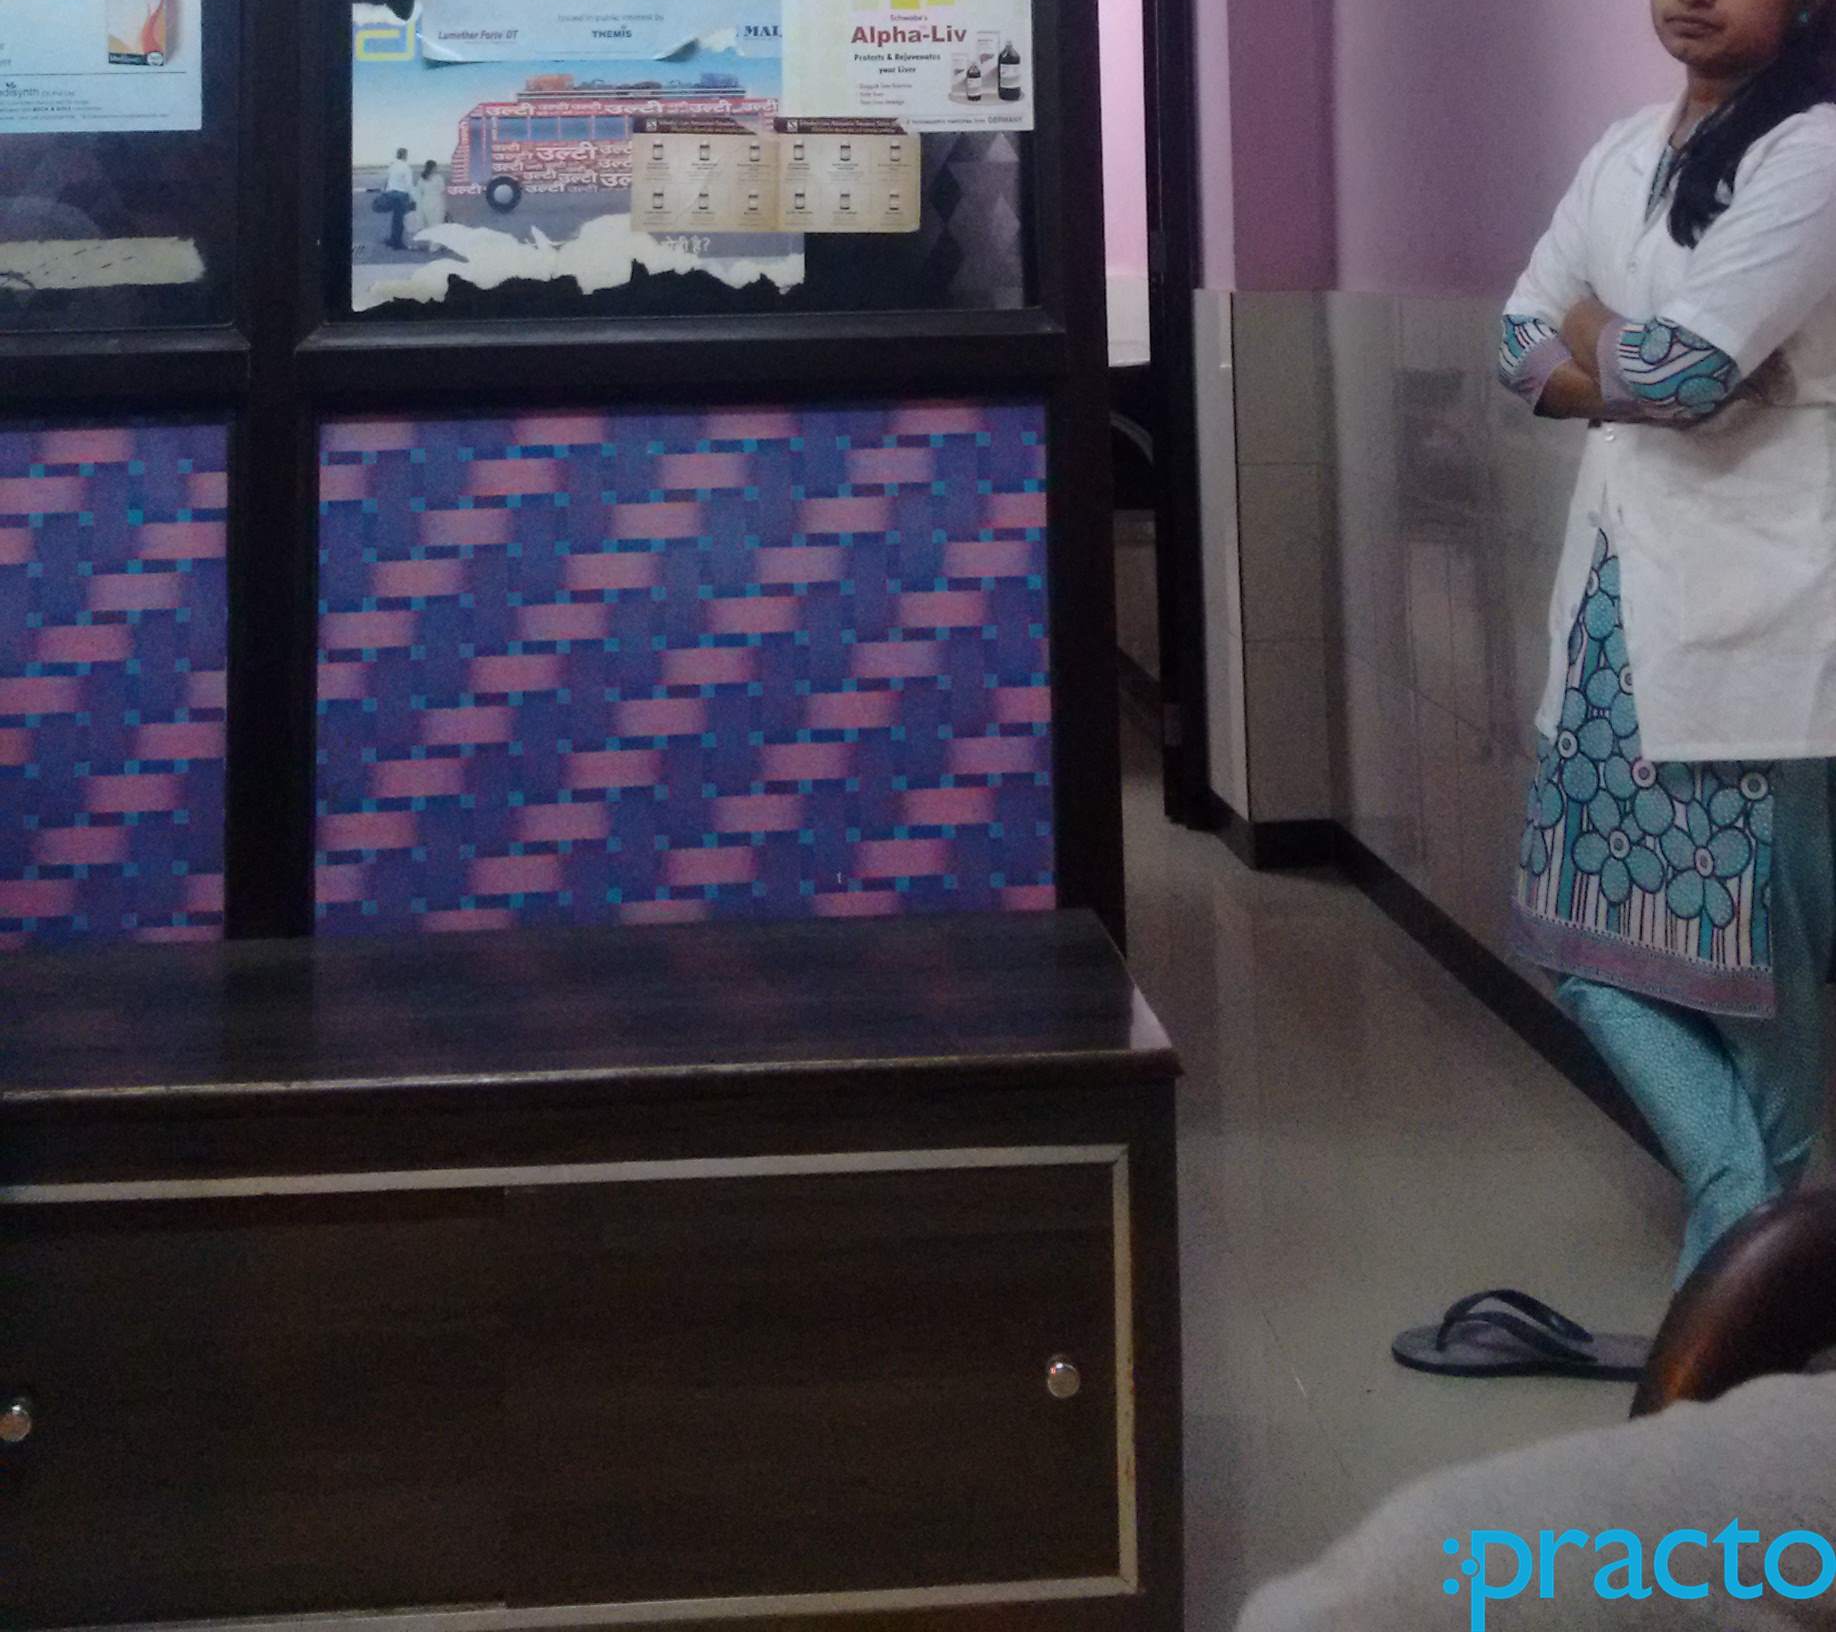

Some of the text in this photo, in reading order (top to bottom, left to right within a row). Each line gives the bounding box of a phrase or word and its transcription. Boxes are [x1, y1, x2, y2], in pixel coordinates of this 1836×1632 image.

[850, 25, 968, 48] Alpha-Liv
[853, 52, 942, 63] Protects & Rejuvenates
[535, 140, 598, 161] उल्टी
